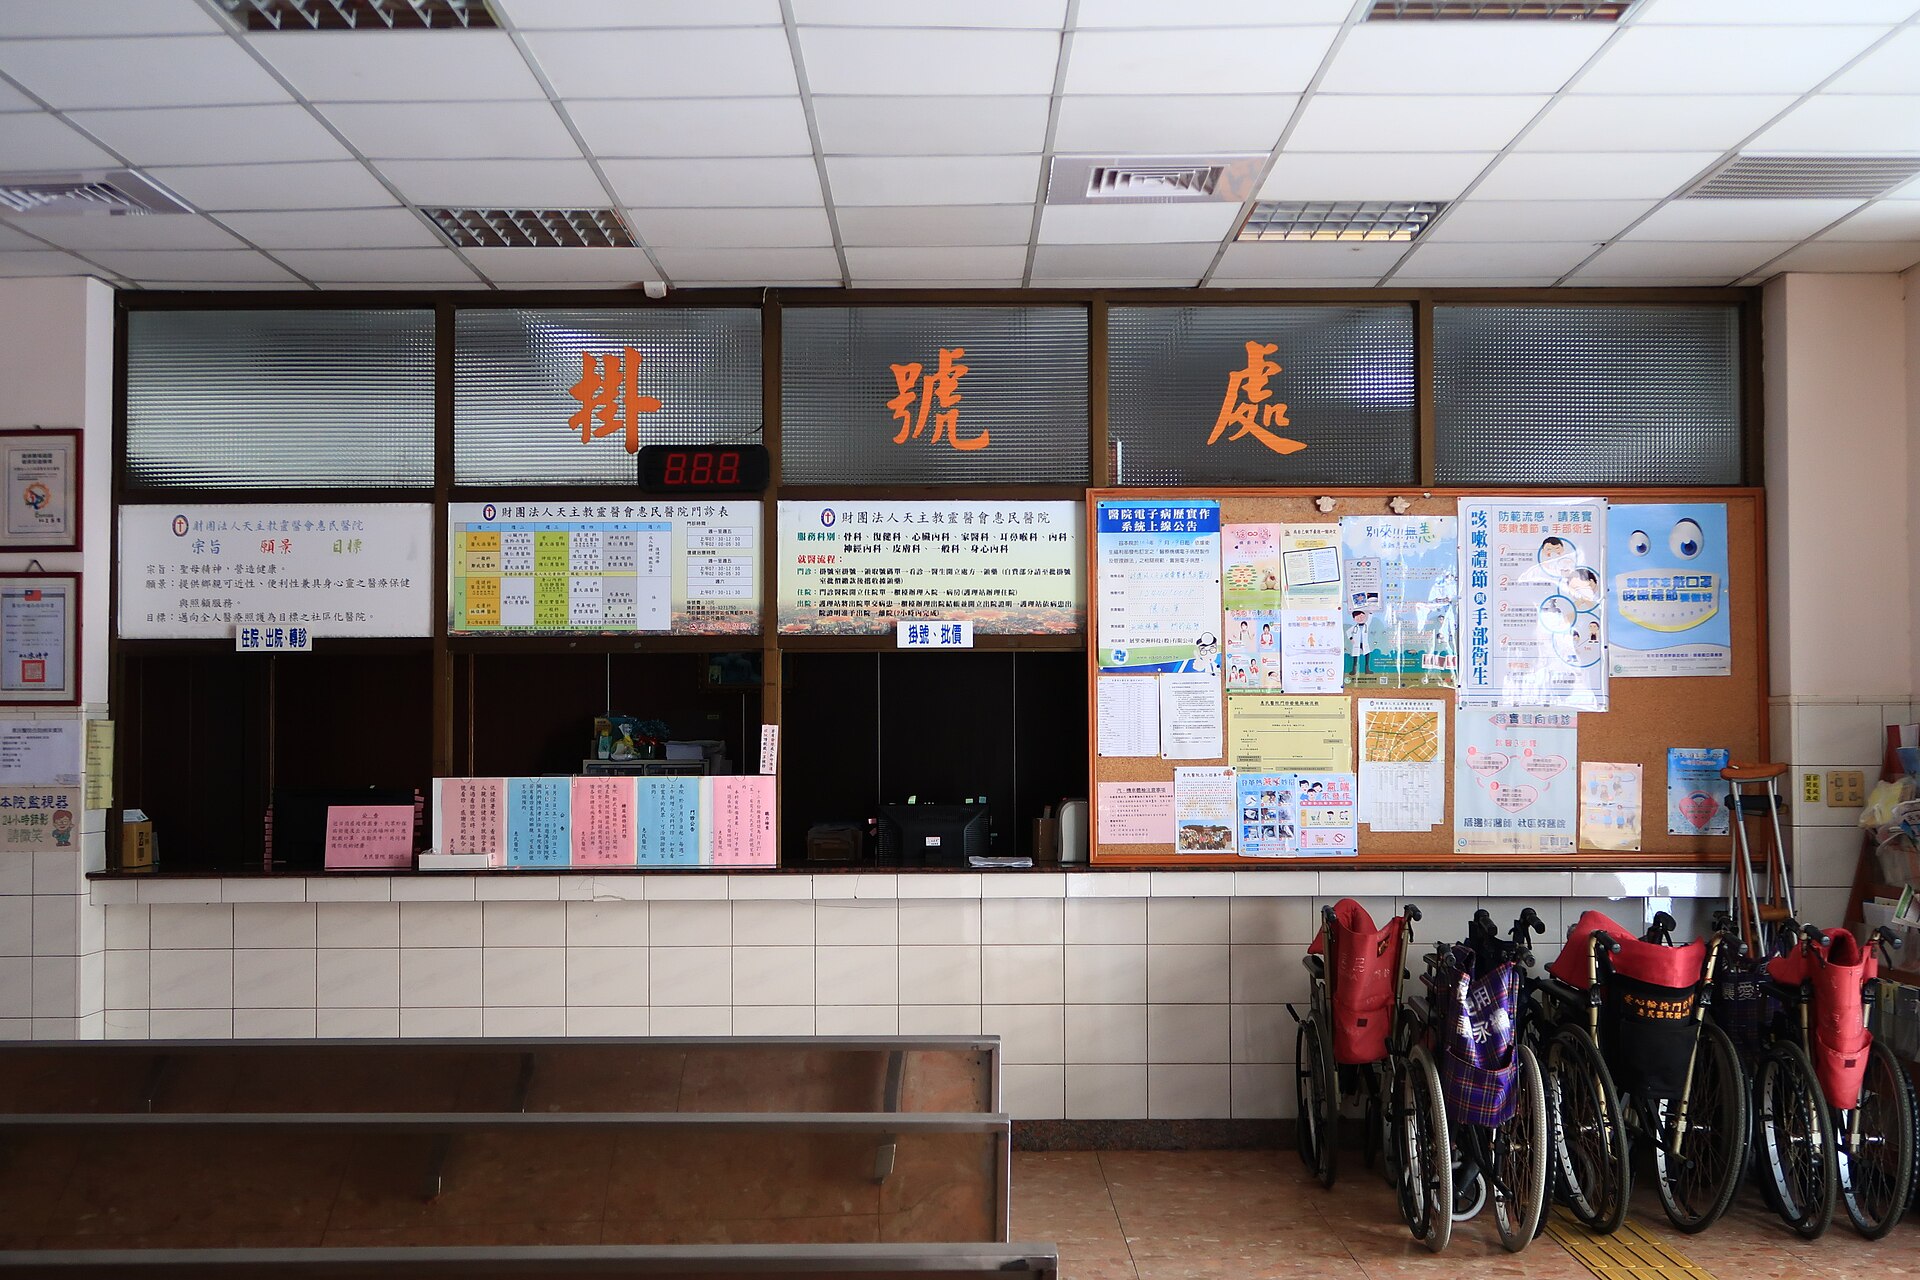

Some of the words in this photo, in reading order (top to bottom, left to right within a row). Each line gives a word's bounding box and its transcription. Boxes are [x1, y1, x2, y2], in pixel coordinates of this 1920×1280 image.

[568, 346, 661, 454] 掛
[886, 348, 990, 450] 號
[1207, 341, 1307, 455] 處
[502, 506, 729, 518] 財團法人天主教靈醫會惠民醫院門診表
[841, 511, 1051, 525] 財團法人天主教靈醫會惠民醫院
[1108, 508, 1211, 520] 醫院電子病歷實作
[1121, 521, 1198, 532] 系統上線公告
[191, 539, 221, 555] 宗旨
[260, 538, 292, 555] 願景
[332, 538, 362, 554] 目標
[908, 624, 962, 645] 掛號、批價
